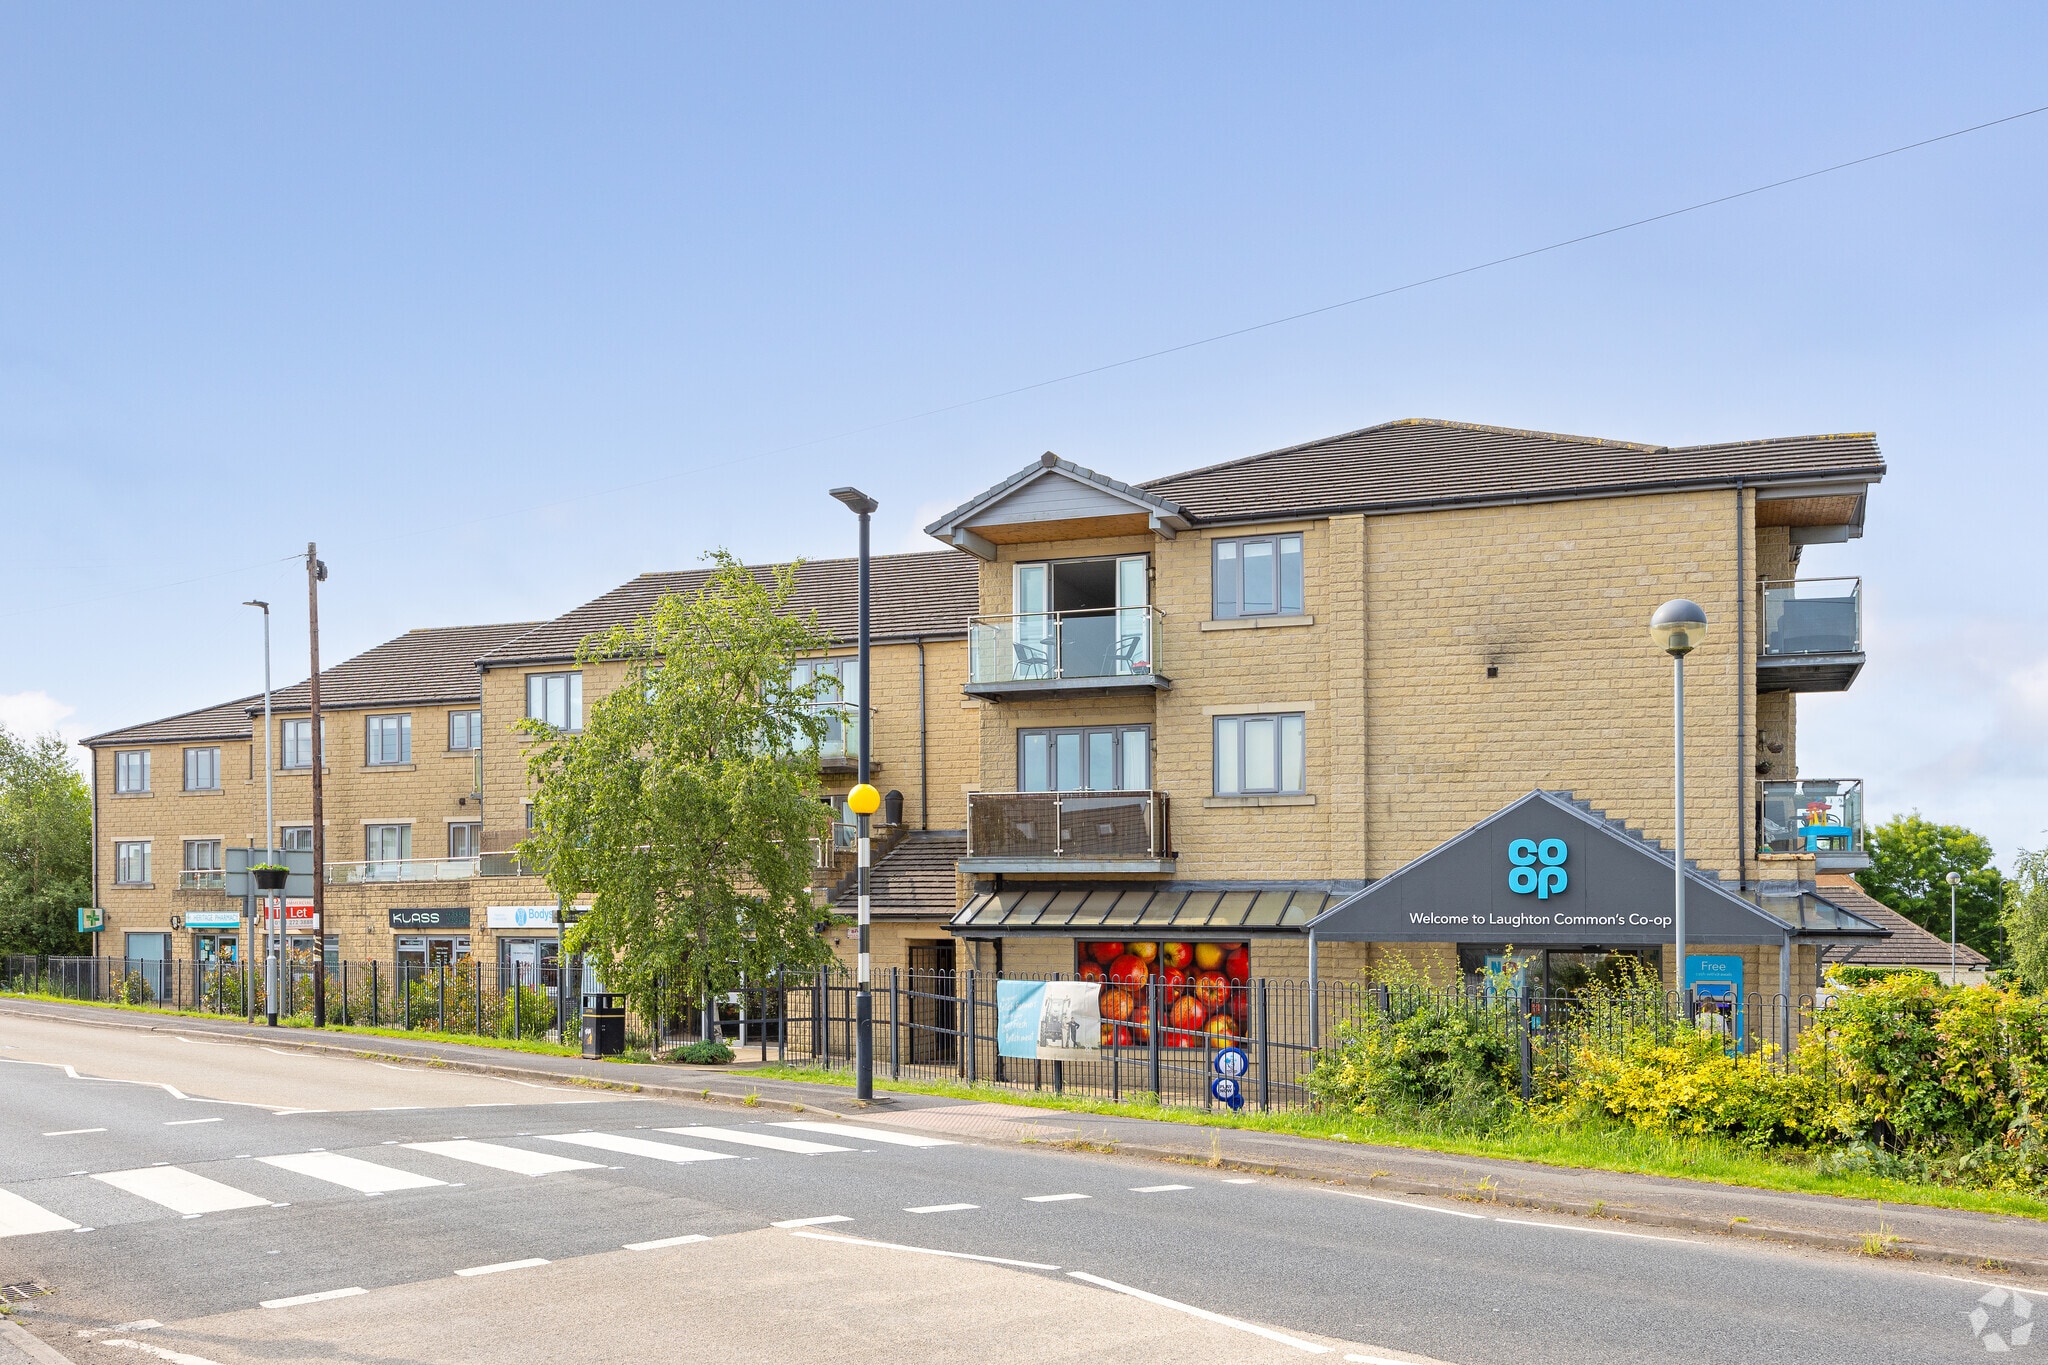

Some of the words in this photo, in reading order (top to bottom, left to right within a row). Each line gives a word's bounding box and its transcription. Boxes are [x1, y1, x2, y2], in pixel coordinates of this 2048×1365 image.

[290, 907, 307, 918] Let
[392, 912, 440, 924] KLASS
[1409, 912, 1469, 924] Welcome
[1472, 914, 1486, 925] to
[1489, 912, 1550, 928] Laughton
[1628, 913, 1672, 929] Co-op
[1701, 961, 1726, 971] Free
